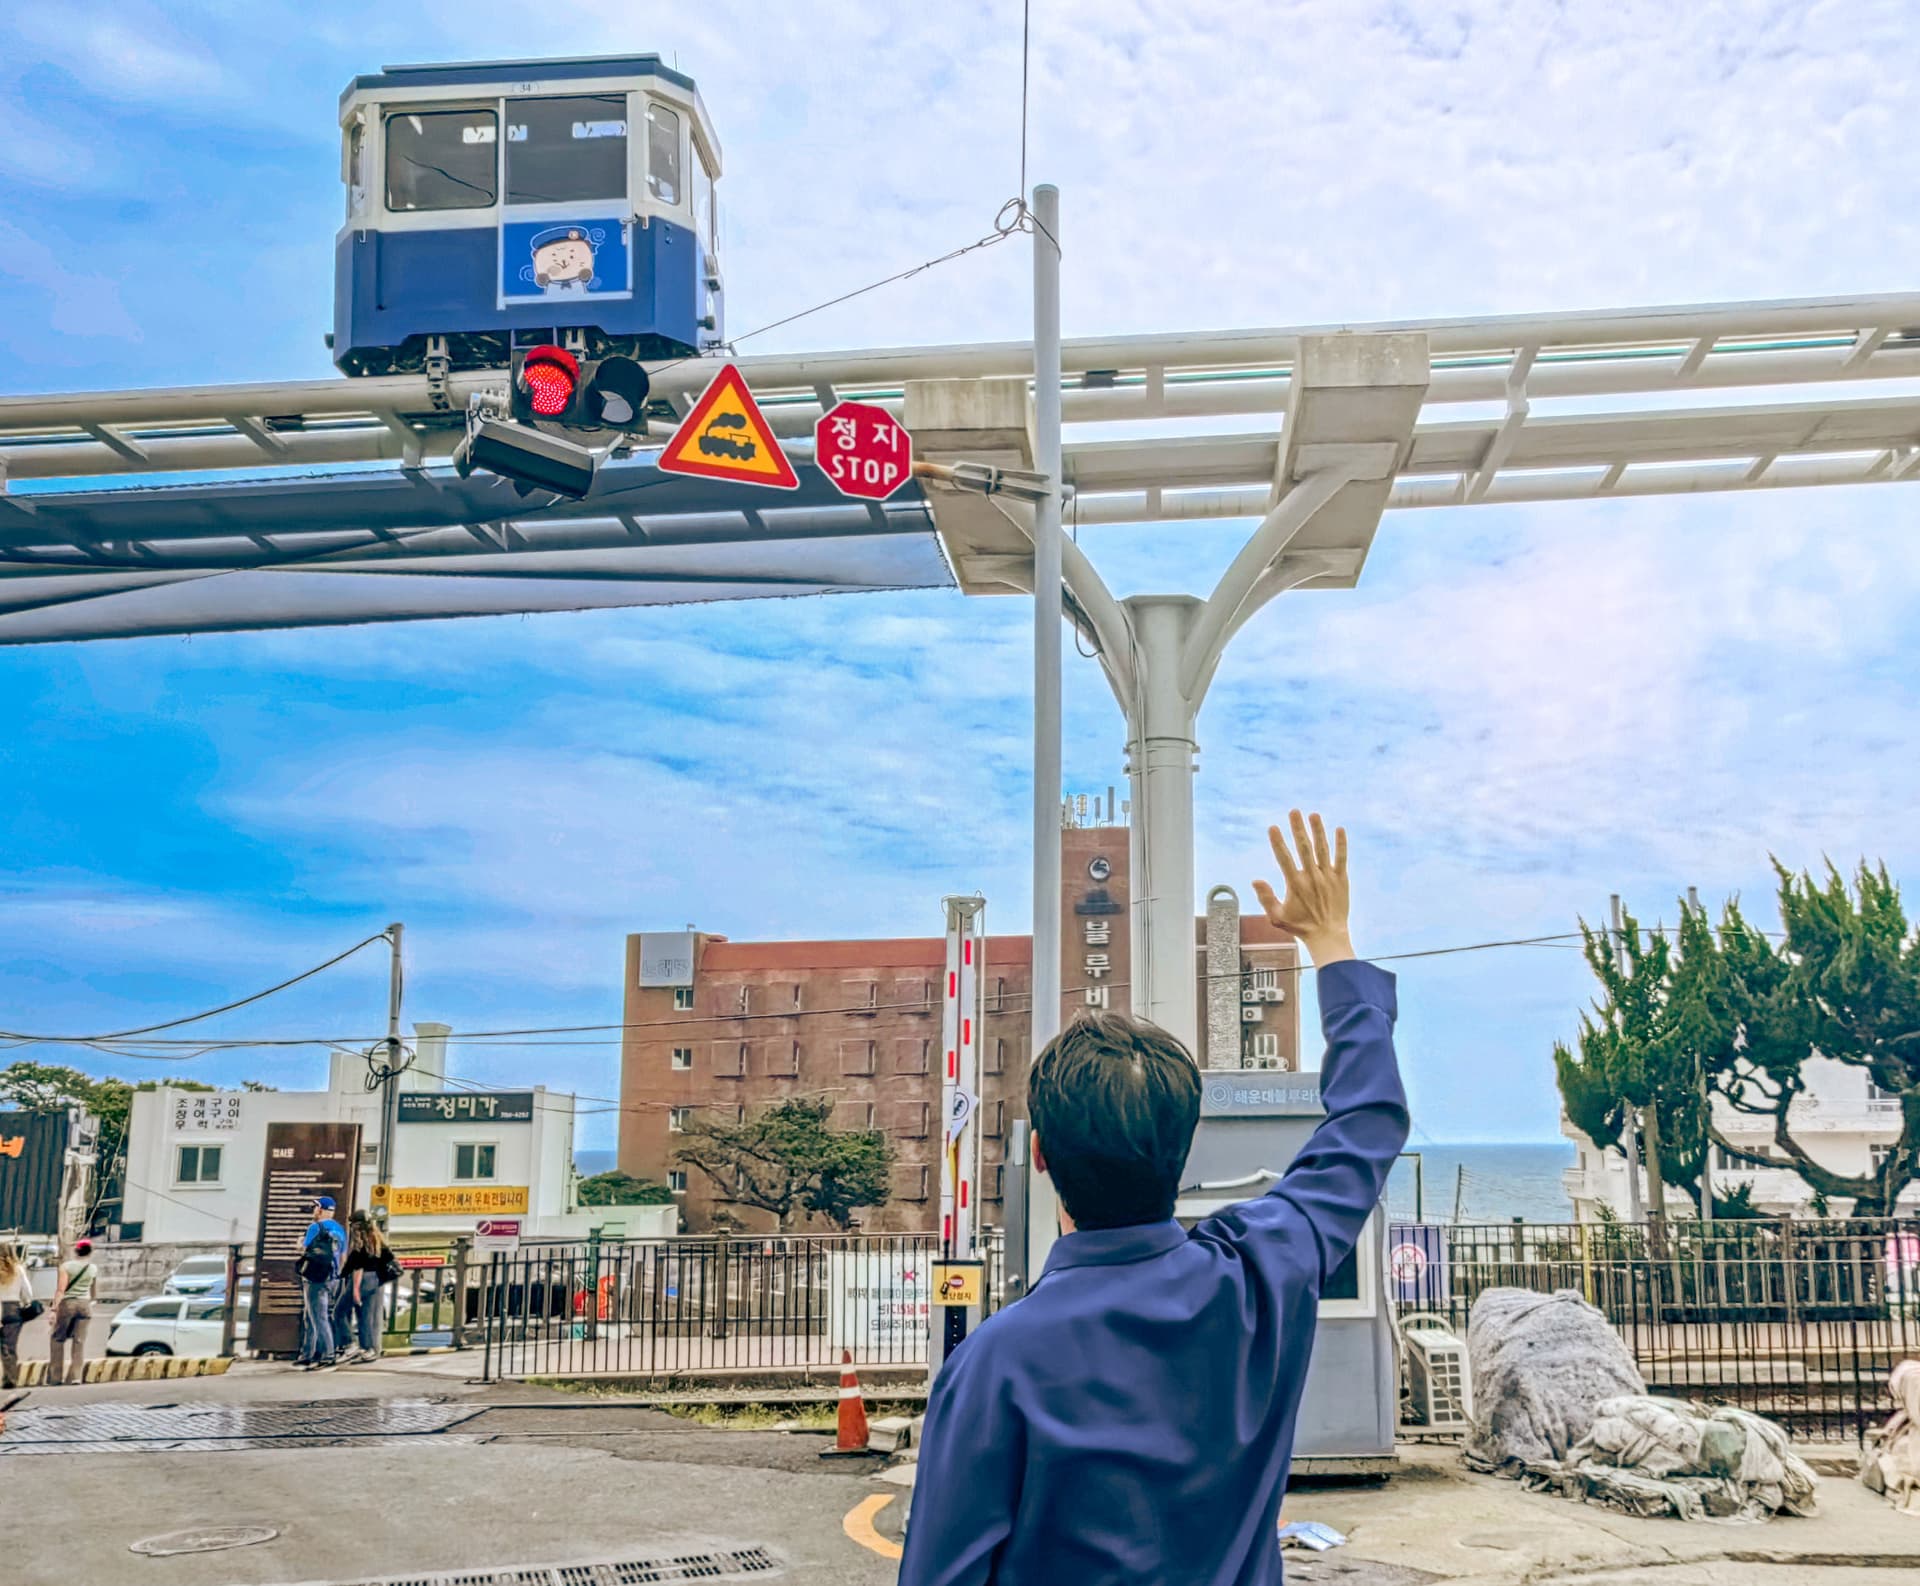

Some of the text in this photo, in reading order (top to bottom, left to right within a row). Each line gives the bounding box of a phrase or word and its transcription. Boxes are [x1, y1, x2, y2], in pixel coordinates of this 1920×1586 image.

[831, 416, 898, 453] 정지
[831, 454, 898, 486] STOP
[176, 1098, 240, 1108] 조개구이
[176, 1109, 240, 1120] 장어구이
